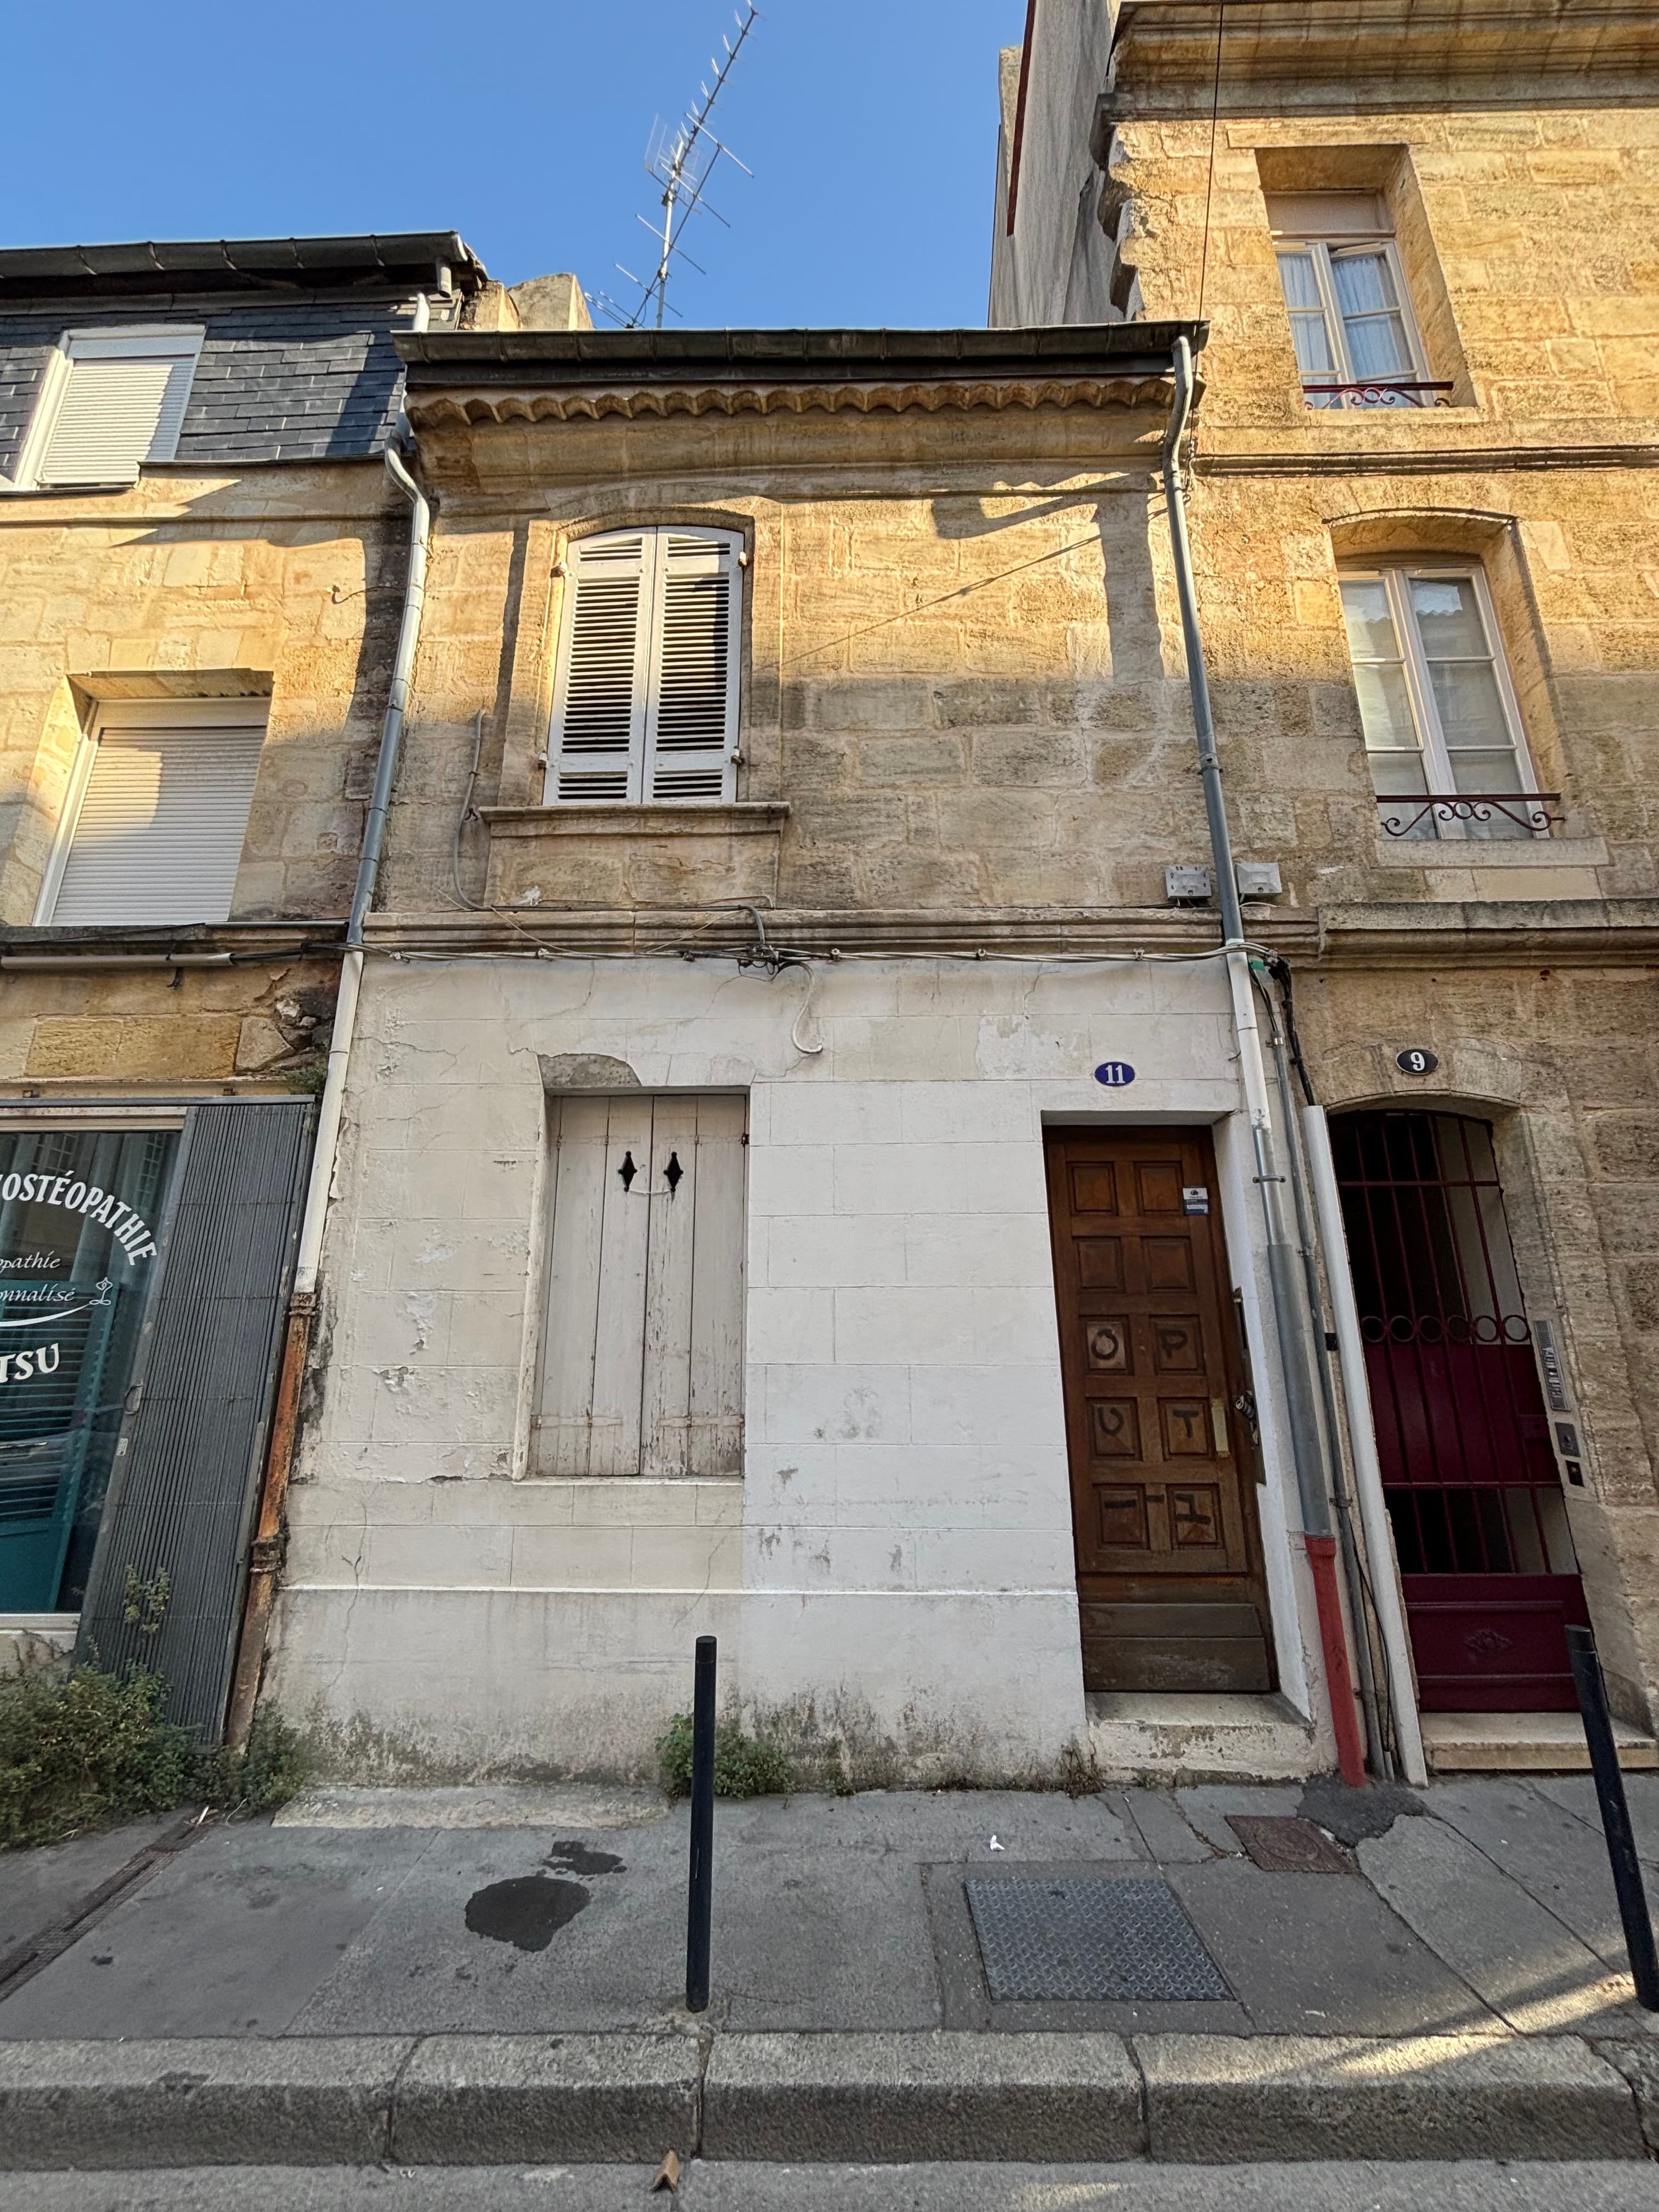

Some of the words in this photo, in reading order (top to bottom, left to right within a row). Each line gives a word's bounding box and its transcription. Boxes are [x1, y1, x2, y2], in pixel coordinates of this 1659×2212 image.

[1410, 1052, 1425, 1071] 9
[1105, 1064, 1126, 1084] 11
[0, 1342, 59, 1383] TSU
